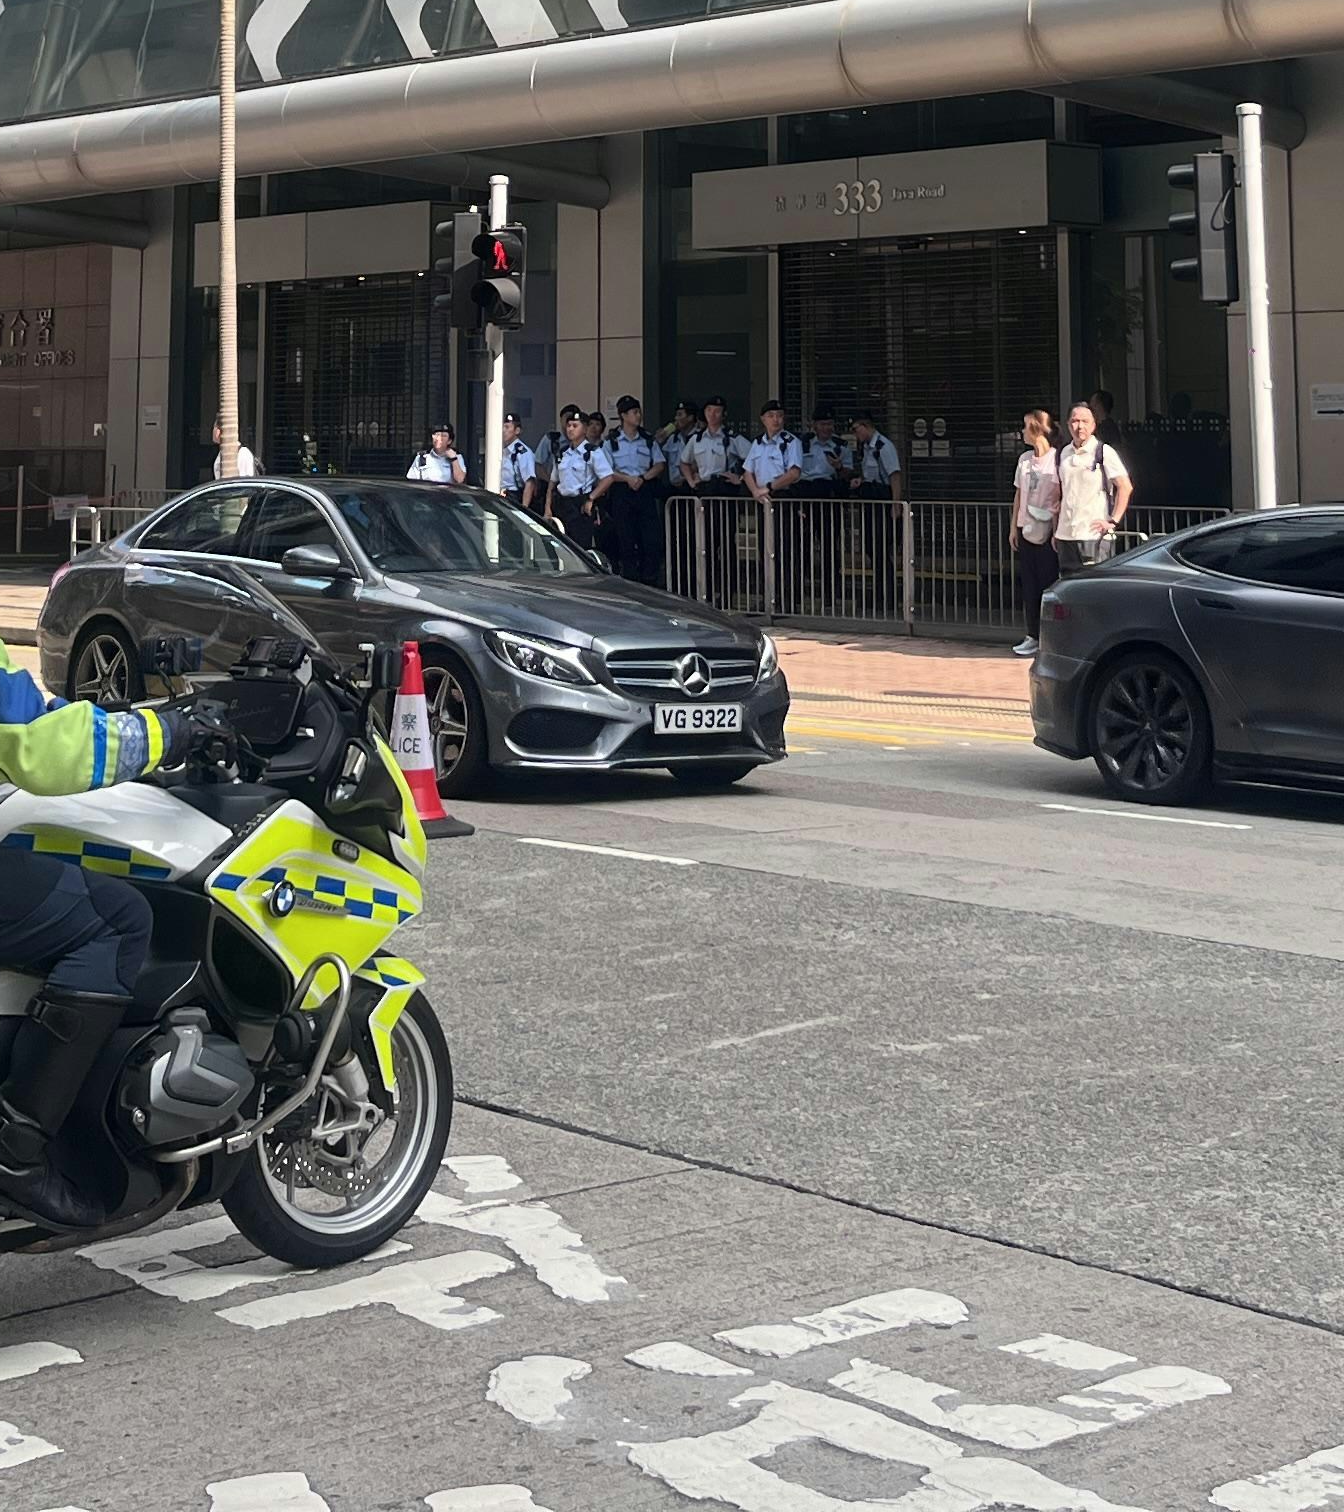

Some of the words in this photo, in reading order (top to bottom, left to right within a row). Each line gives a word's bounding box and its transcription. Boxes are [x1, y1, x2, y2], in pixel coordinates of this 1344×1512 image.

[833, 179, 882, 215] 333
[891, 188, 914, 200] Java
[917, 184, 945, 198] Road
[662, 709, 687, 729] VG
[693, 708, 737, 729] 9322
